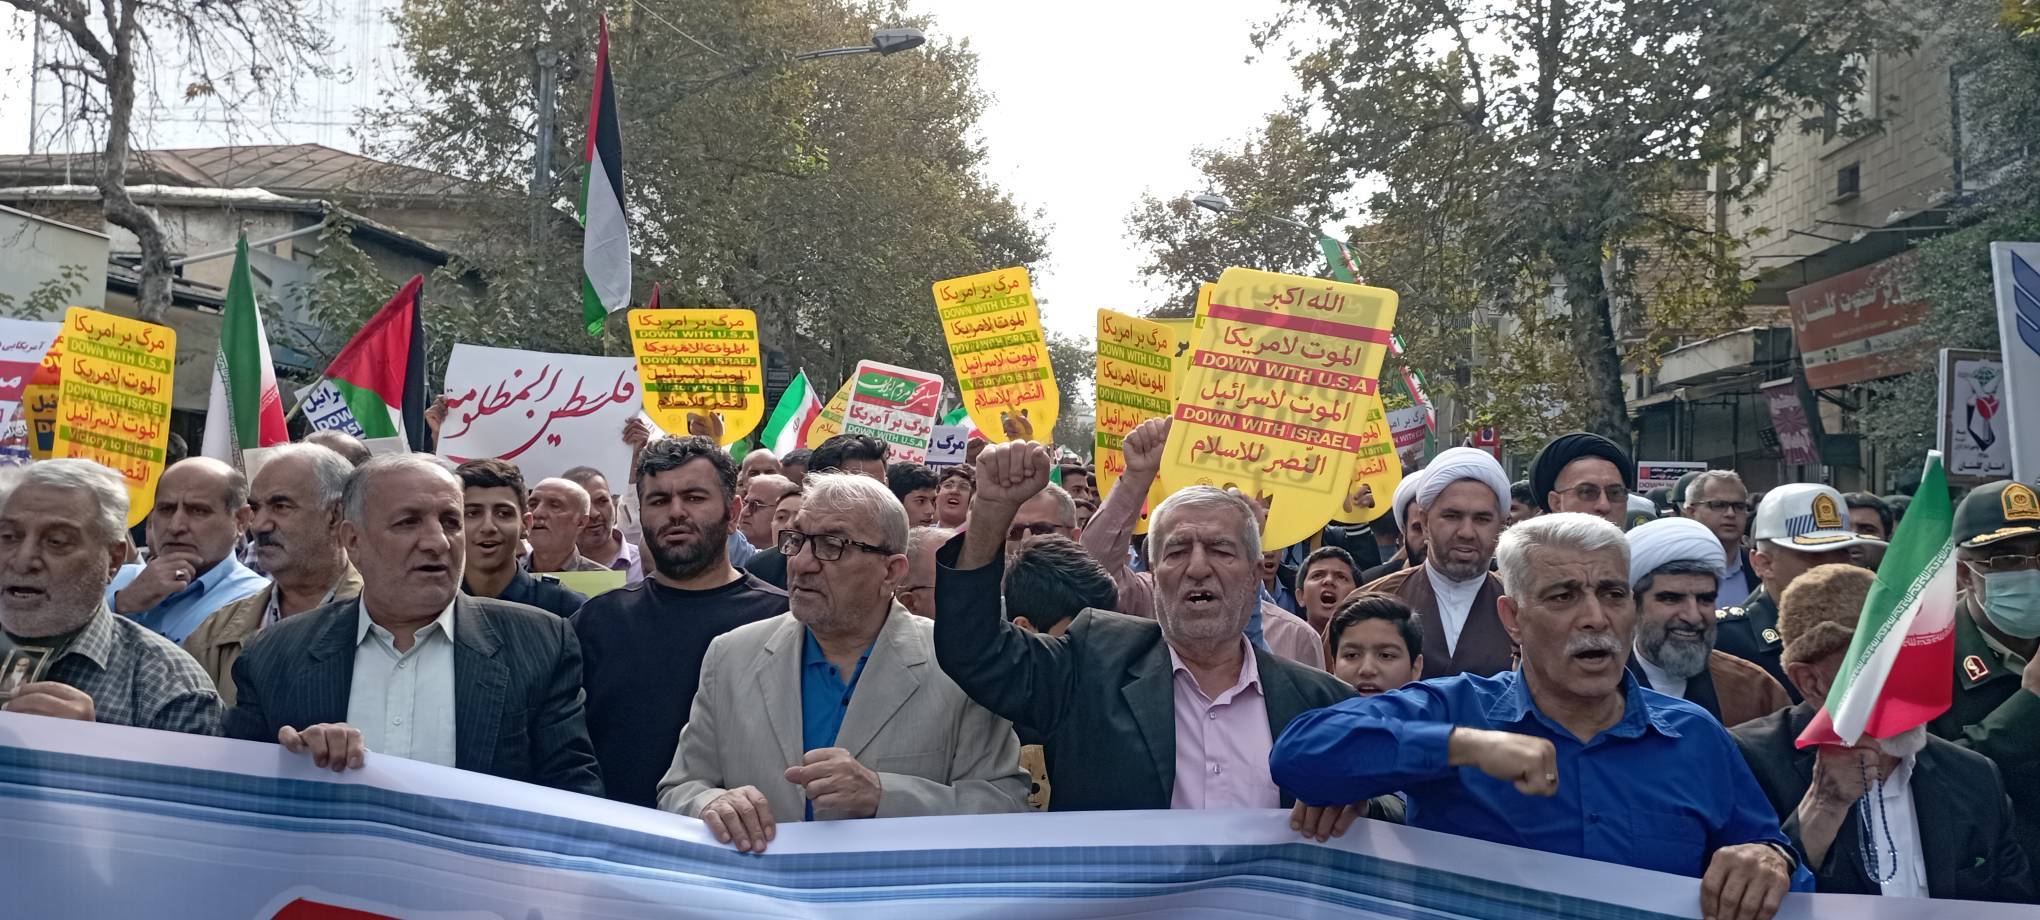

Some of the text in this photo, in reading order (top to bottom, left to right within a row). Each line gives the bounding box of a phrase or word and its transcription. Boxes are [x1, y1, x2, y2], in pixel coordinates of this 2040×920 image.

[981, 285, 993, 299] بر
[994, 274, 1019, 295] مرگ
[944, 306, 972, 319] DOWN
[975, 301, 999, 314] WITH
[694, 321, 707, 330] بر
[711, 314, 744, 329] مرگ
[118, 332, 132, 349] بر
[136, 327, 165, 353] مرگ
[639, 330, 750, 339] DOWN WITH U.S.A
[1147, 328, 1167, 352] مرگ
[71, 339, 104, 358] DOWN
[107, 347, 135, 363] WITH
[642, 356, 679, 365] DOWN
[1101, 342, 1126, 358] DOWN
[1127, 348, 1148, 365] WITH
[1301, 342, 1361, 368] الموت
[123, 371, 161, 396] الموت
[1203, 353, 1368, 393] DOWN WITH U.S.A
[66, 383, 98, 400] DOWN
[100, 390, 125, 405] WITH
[656, 383, 699, 394] Victory
[702, 384, 713, 392] to
[1143, 395, 1168, 412] ISRAEL
[1289, 395, 1351, 423] الموت
[122, 416, 160, 440] الموت
[317, 410, 353, 431] DOW
[888, 419, 902, 432] بر
[904, 419, 931, 437] مرگ
[1183, 406, 1352, 450] DOWN WITH ISRAEL
[848, 424, 874, 437] DOWN
[877, 430, 899, 443] WITH
[1363, 422, 1382, 443] المو
[110, 439, 121, 449] to
[937, 434, 965, 455] مرگ
